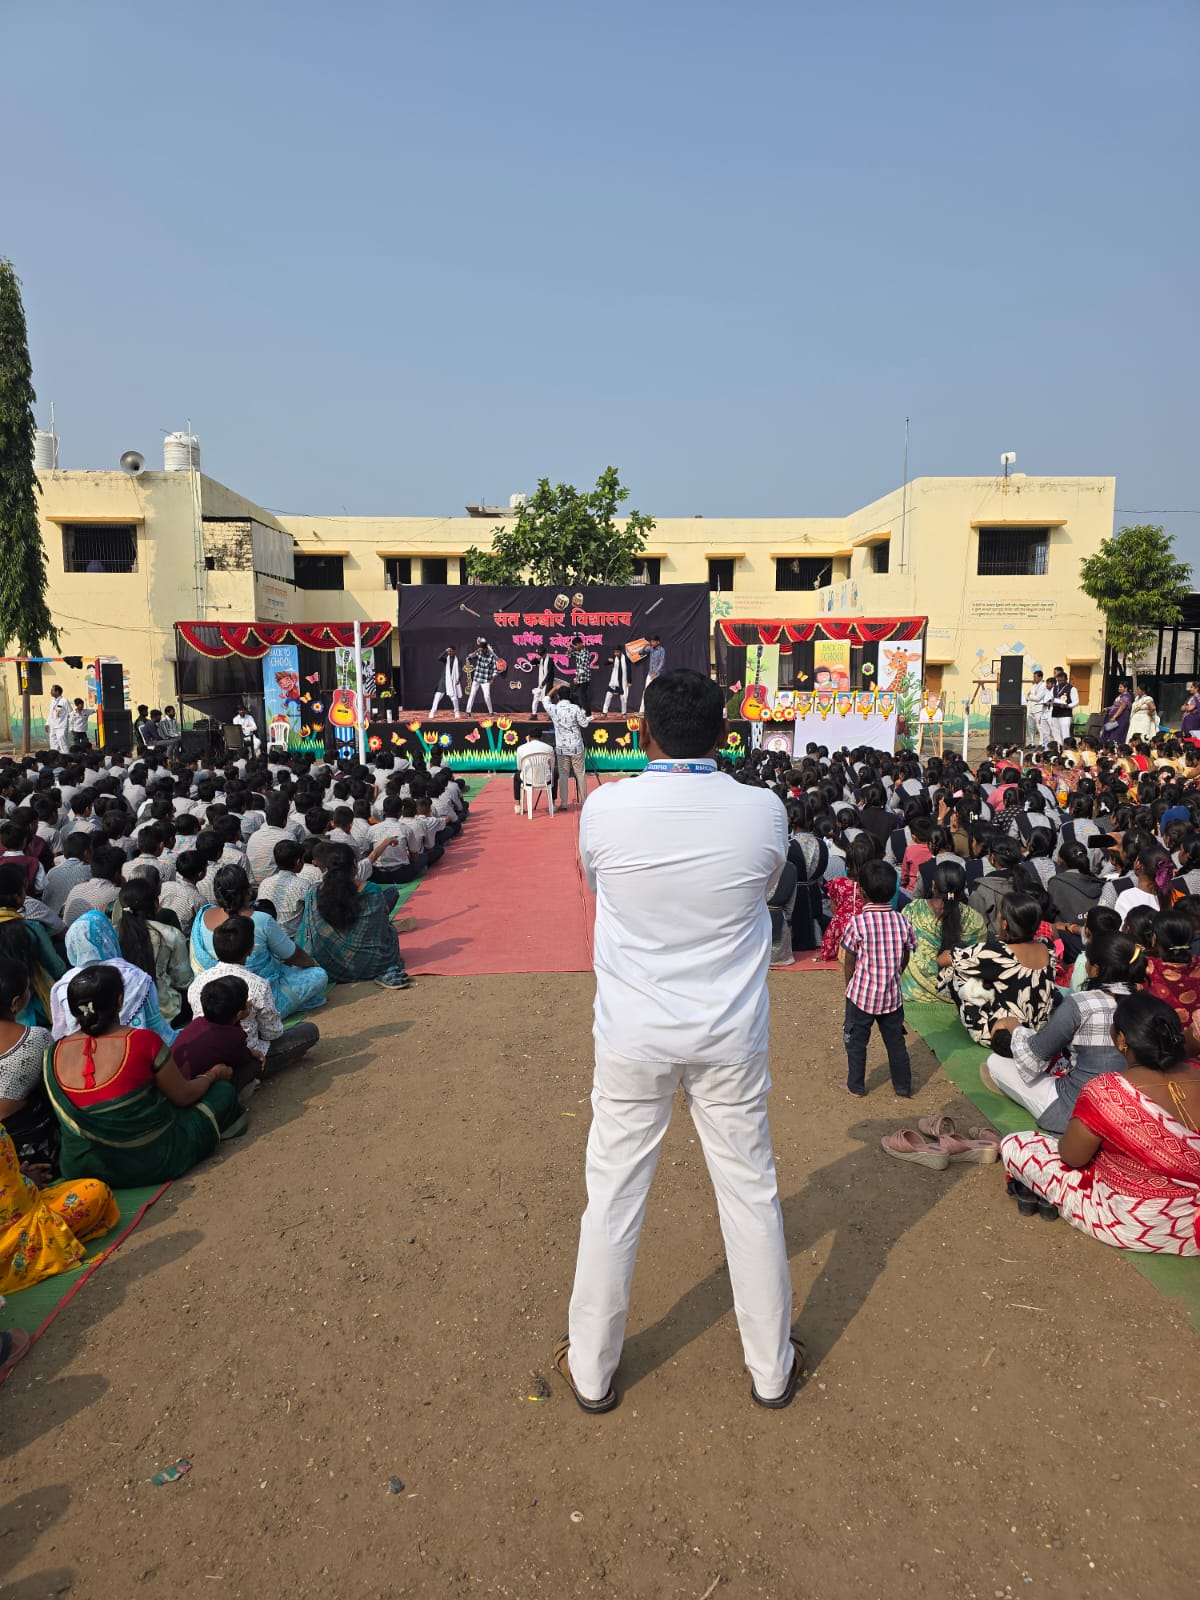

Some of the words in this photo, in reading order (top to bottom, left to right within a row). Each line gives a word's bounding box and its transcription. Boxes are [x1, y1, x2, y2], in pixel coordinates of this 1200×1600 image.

[493, 609, 520, 627] संत
[522, 609, 566, 628] कबीर
[571, 608, 632, 627] विद्यालय
